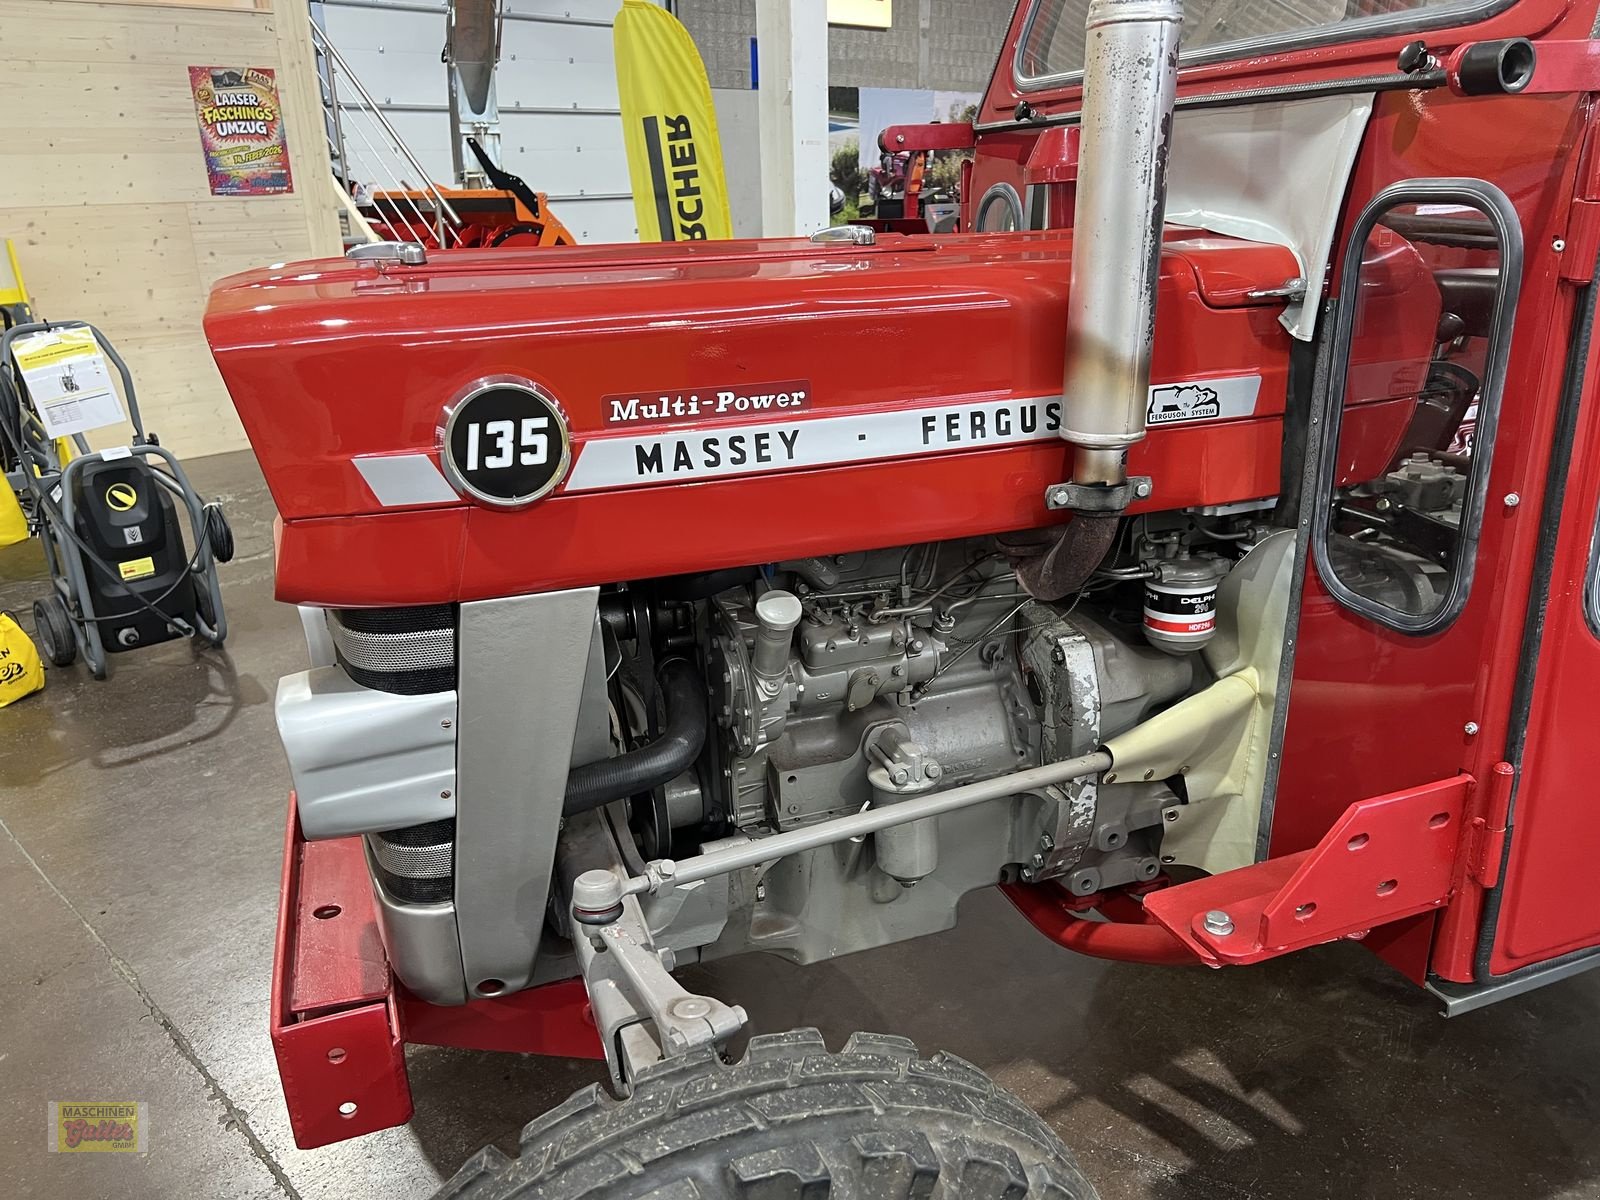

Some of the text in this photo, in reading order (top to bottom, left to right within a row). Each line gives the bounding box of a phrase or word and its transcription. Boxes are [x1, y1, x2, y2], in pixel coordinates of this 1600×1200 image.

[215, 93, 258, 106] LAASER
[203, 107, 274, 124] FASCHINGS
[216, 121, 267, 137] UMZUG
[608, 389, 806, 422] Multi-Power
[1151, 408, 1215, 421] FERGUSON SYSTEM
[466, 416, 548, 471] 135
[635, 429, 800, 475] MASSEY
[922, 402, 1061, 445] FERGUS
[1181, 593, 1215, 604] DELPHI
[1194, 603, 1209, 614] 296
[1188, 622, 1210, 631] HDF296
